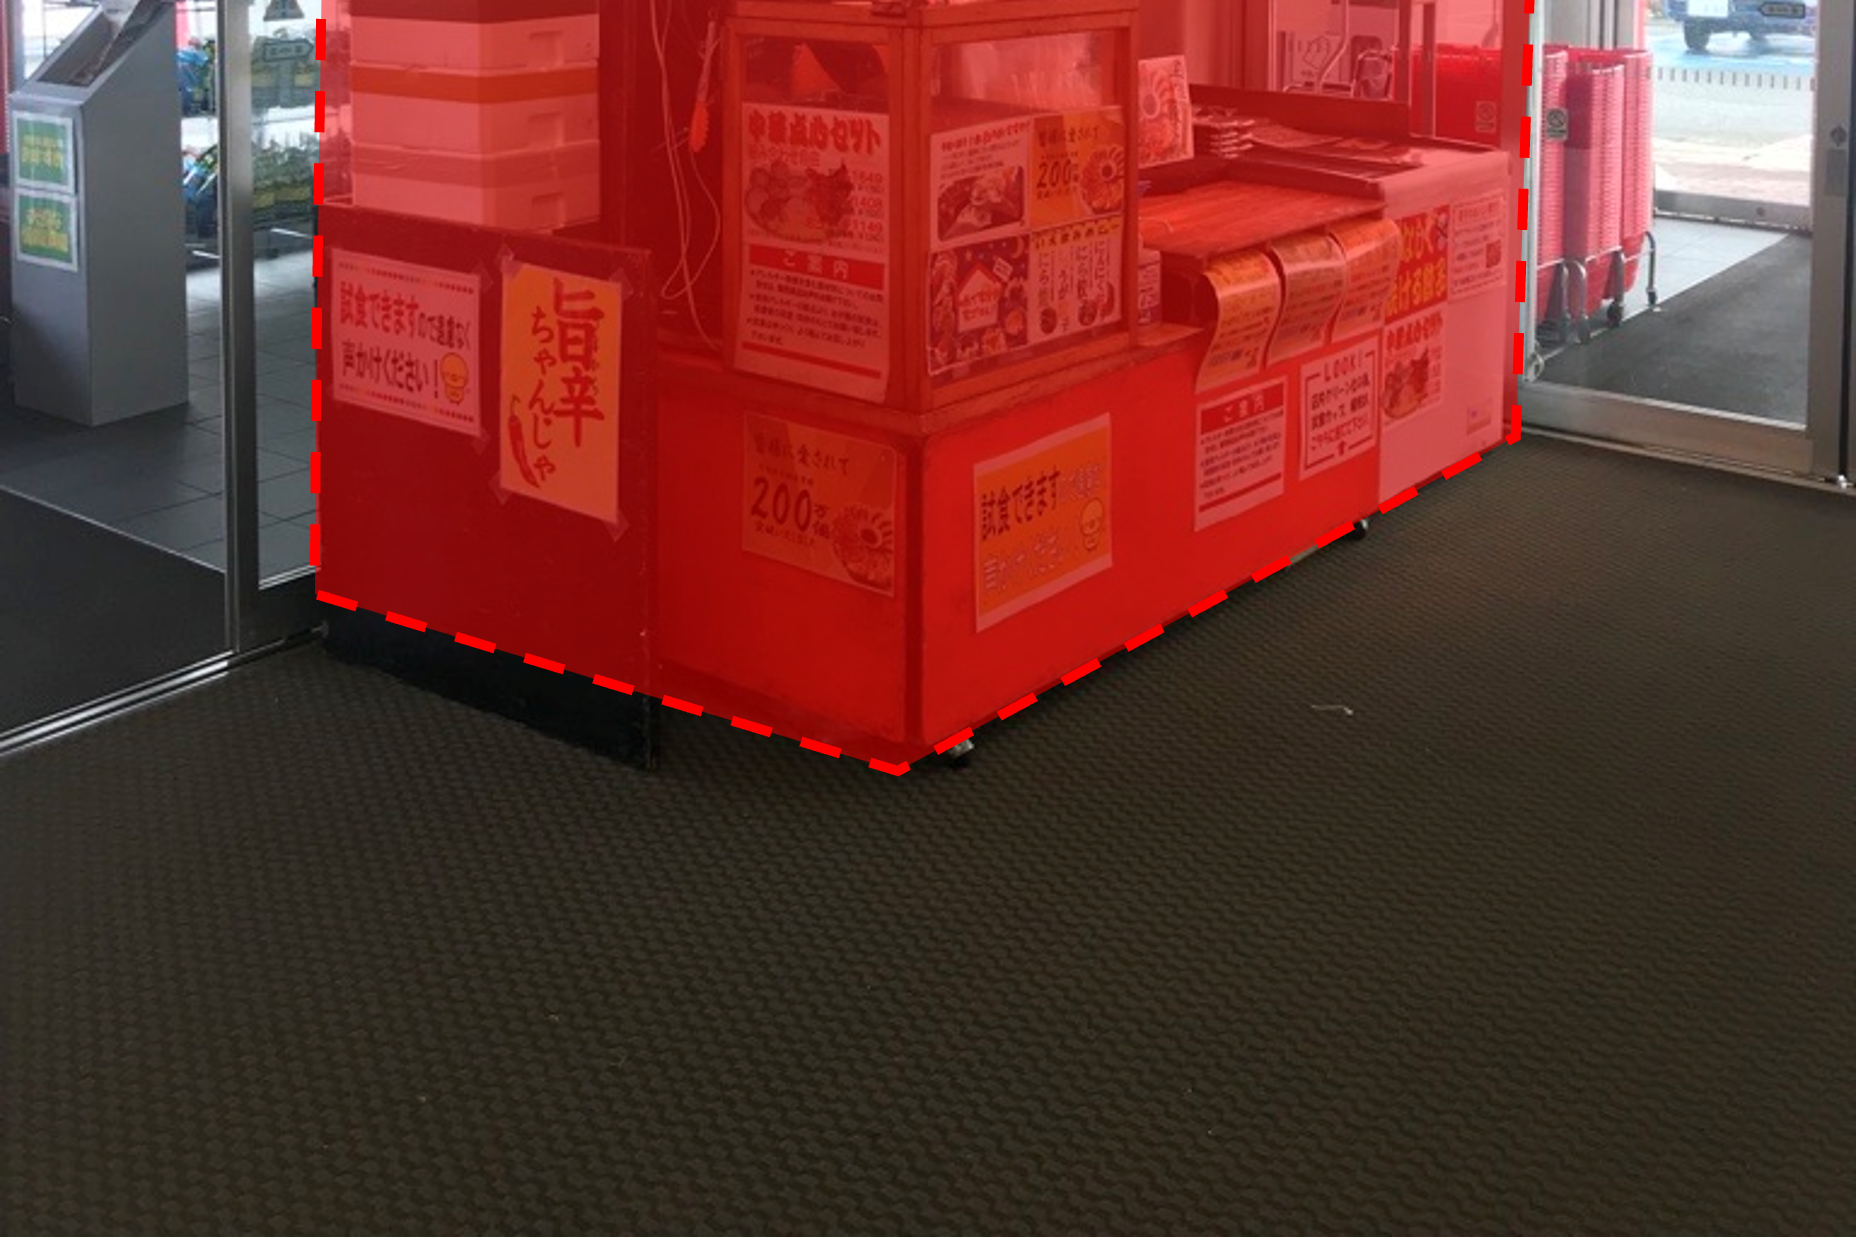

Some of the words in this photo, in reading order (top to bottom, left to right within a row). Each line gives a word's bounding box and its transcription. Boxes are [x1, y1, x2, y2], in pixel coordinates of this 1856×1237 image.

[783, 251, 850, 281] ご案内
[529, 307, 556, 482] ちゃんじゃ
[553, 278, 605, 449] 旨辛
[750, 476, 812, 533] 200
